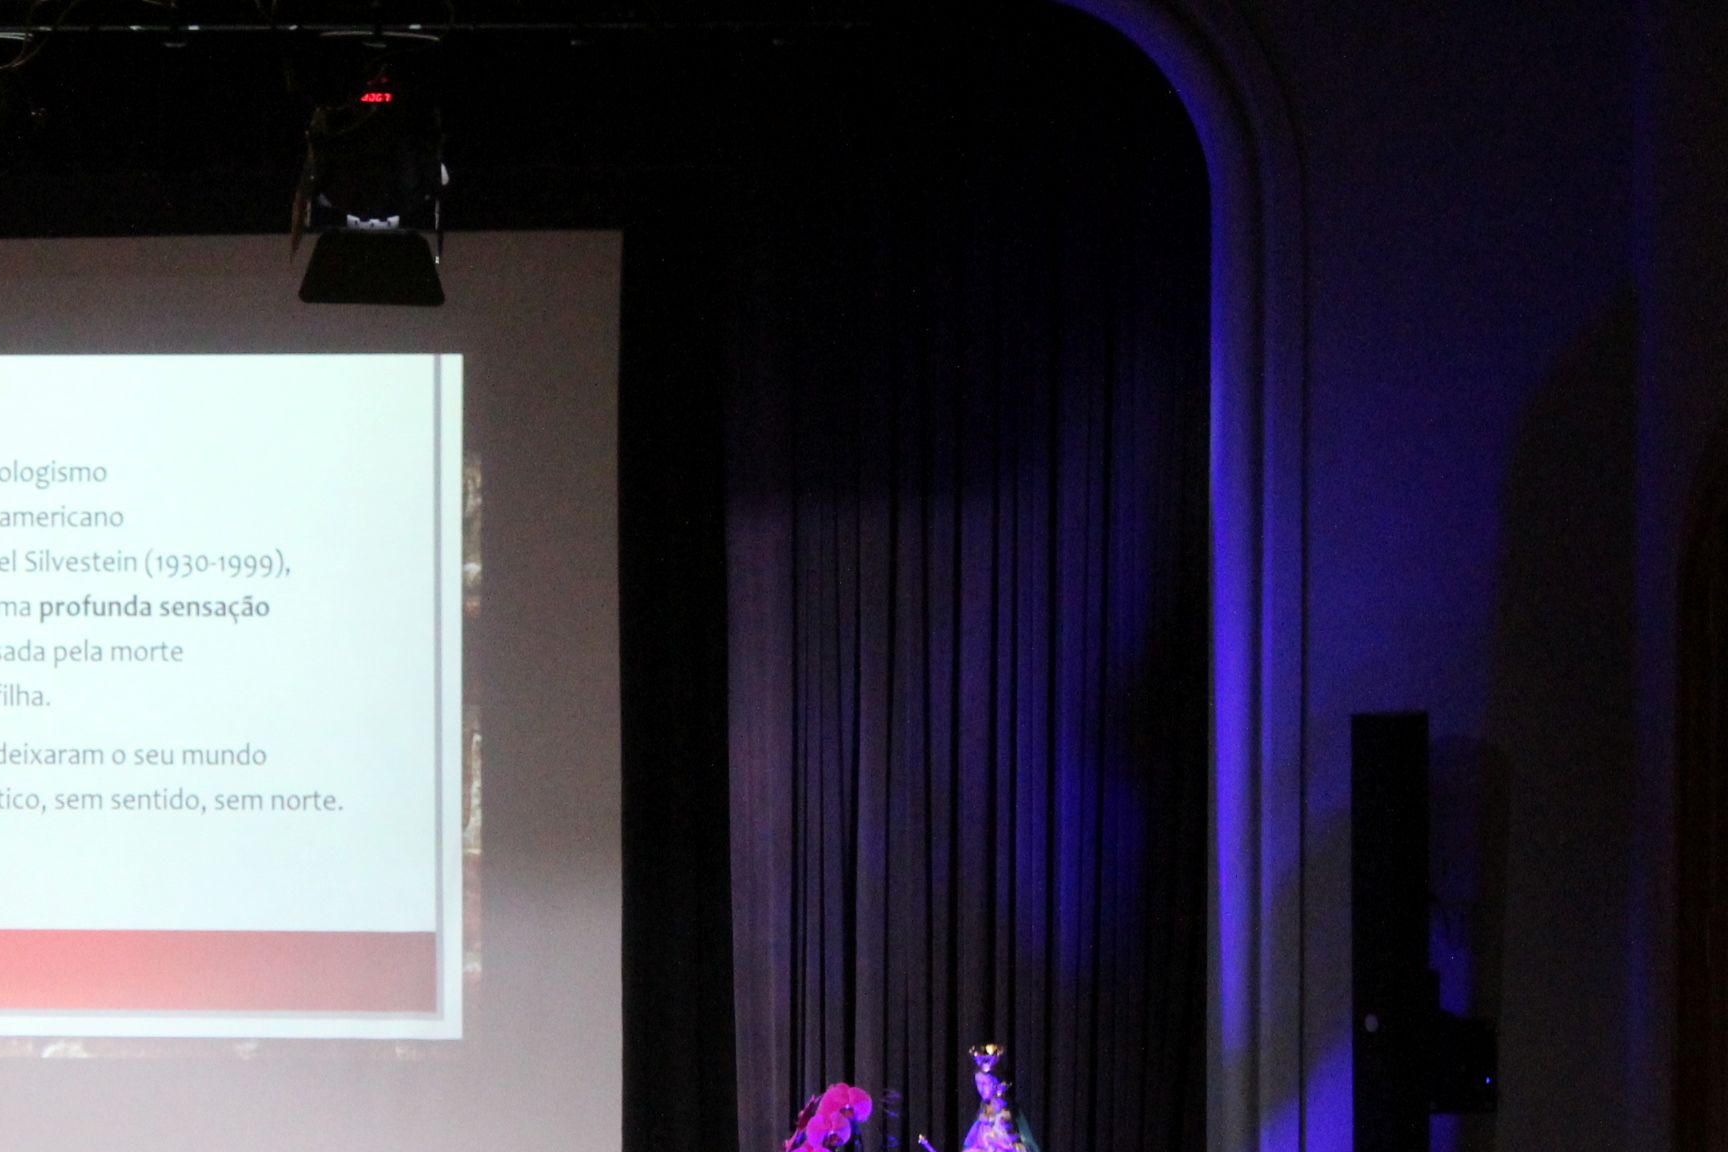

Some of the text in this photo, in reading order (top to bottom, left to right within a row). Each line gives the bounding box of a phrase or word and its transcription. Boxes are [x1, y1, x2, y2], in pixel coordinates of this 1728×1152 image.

[24, 548, 138, 573] Silvestein
[144, 548, 291, 579] (1930-1999),
[38, 593, 153, 623] profunda
[159, 594, 271, 623] sensação
[53, 638, 104, 669] pela
[110, 641, 184, 662] morte
[111, 748, 127, 766] o
[133, 748, 175, 766] seu
[181, 742, 268, 766] mundo
[54, 793, 104, 810] sem
[110, 787, 207, 814] sentido,
[214, 793, 264, 811] sem
[270, 790, 343, 811] norte.
